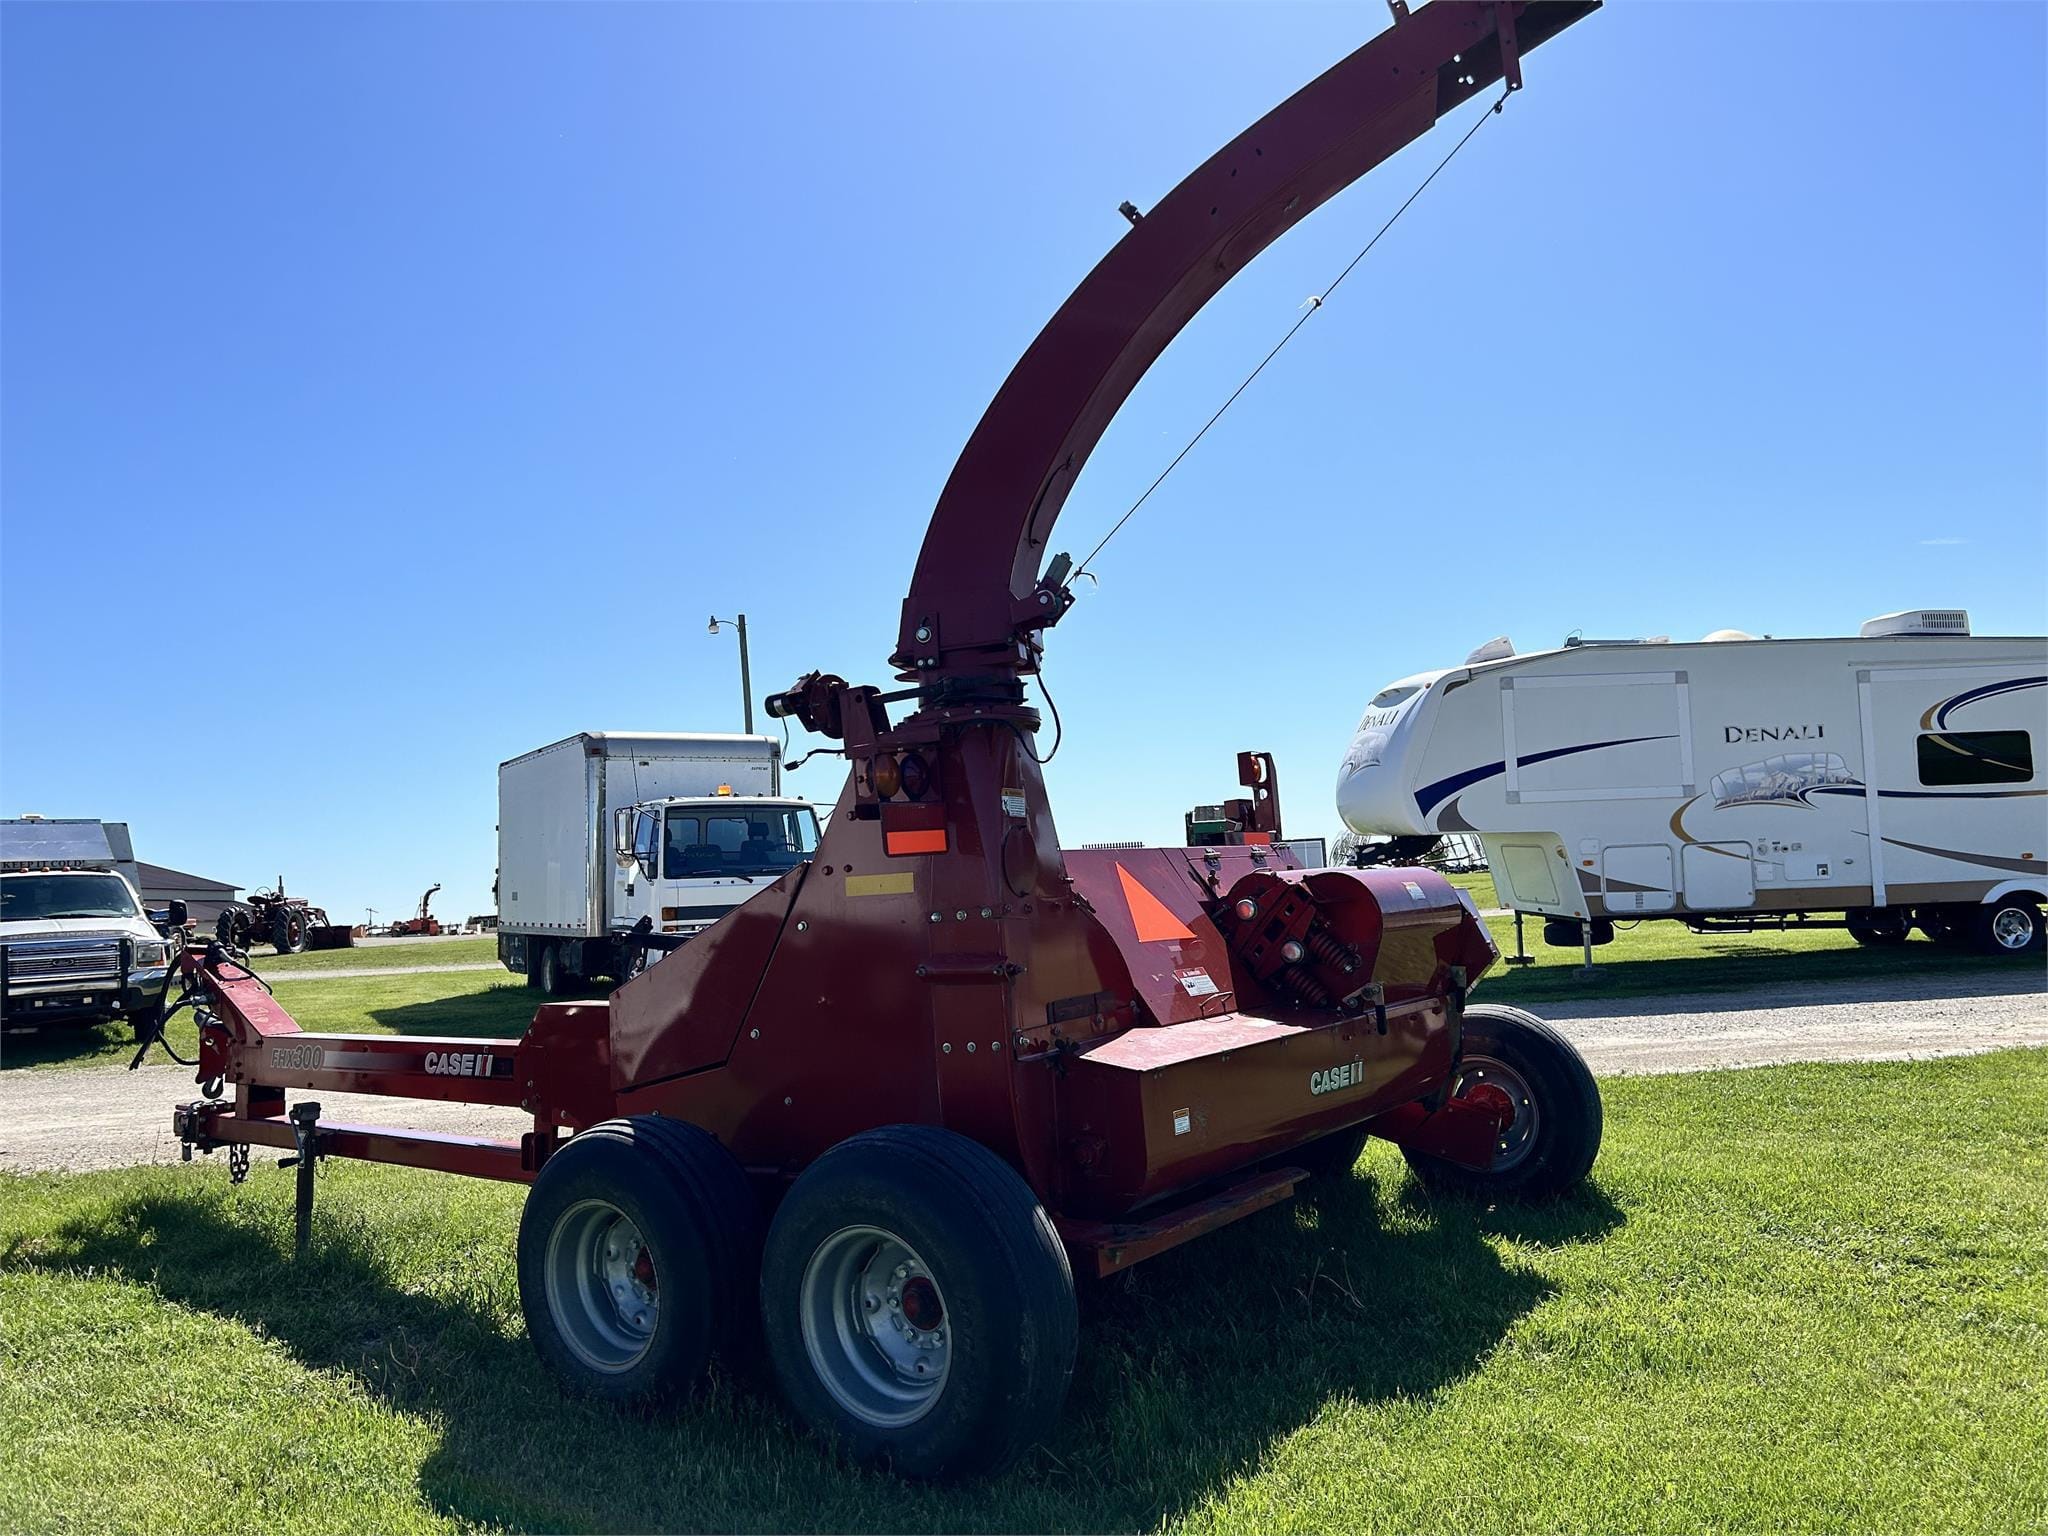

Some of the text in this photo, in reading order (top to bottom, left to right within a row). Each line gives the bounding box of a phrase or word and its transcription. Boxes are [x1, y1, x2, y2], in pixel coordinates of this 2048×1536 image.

[1724, 725, 1824, 743] DENALI
[3, 859, 85, 869] KEEP IT COLD!
[270, 1044, 323, 1071] FHX300
[424, 1051, 475, 1076] CASE
[1311, 1064, 1350, 1095] CASE
